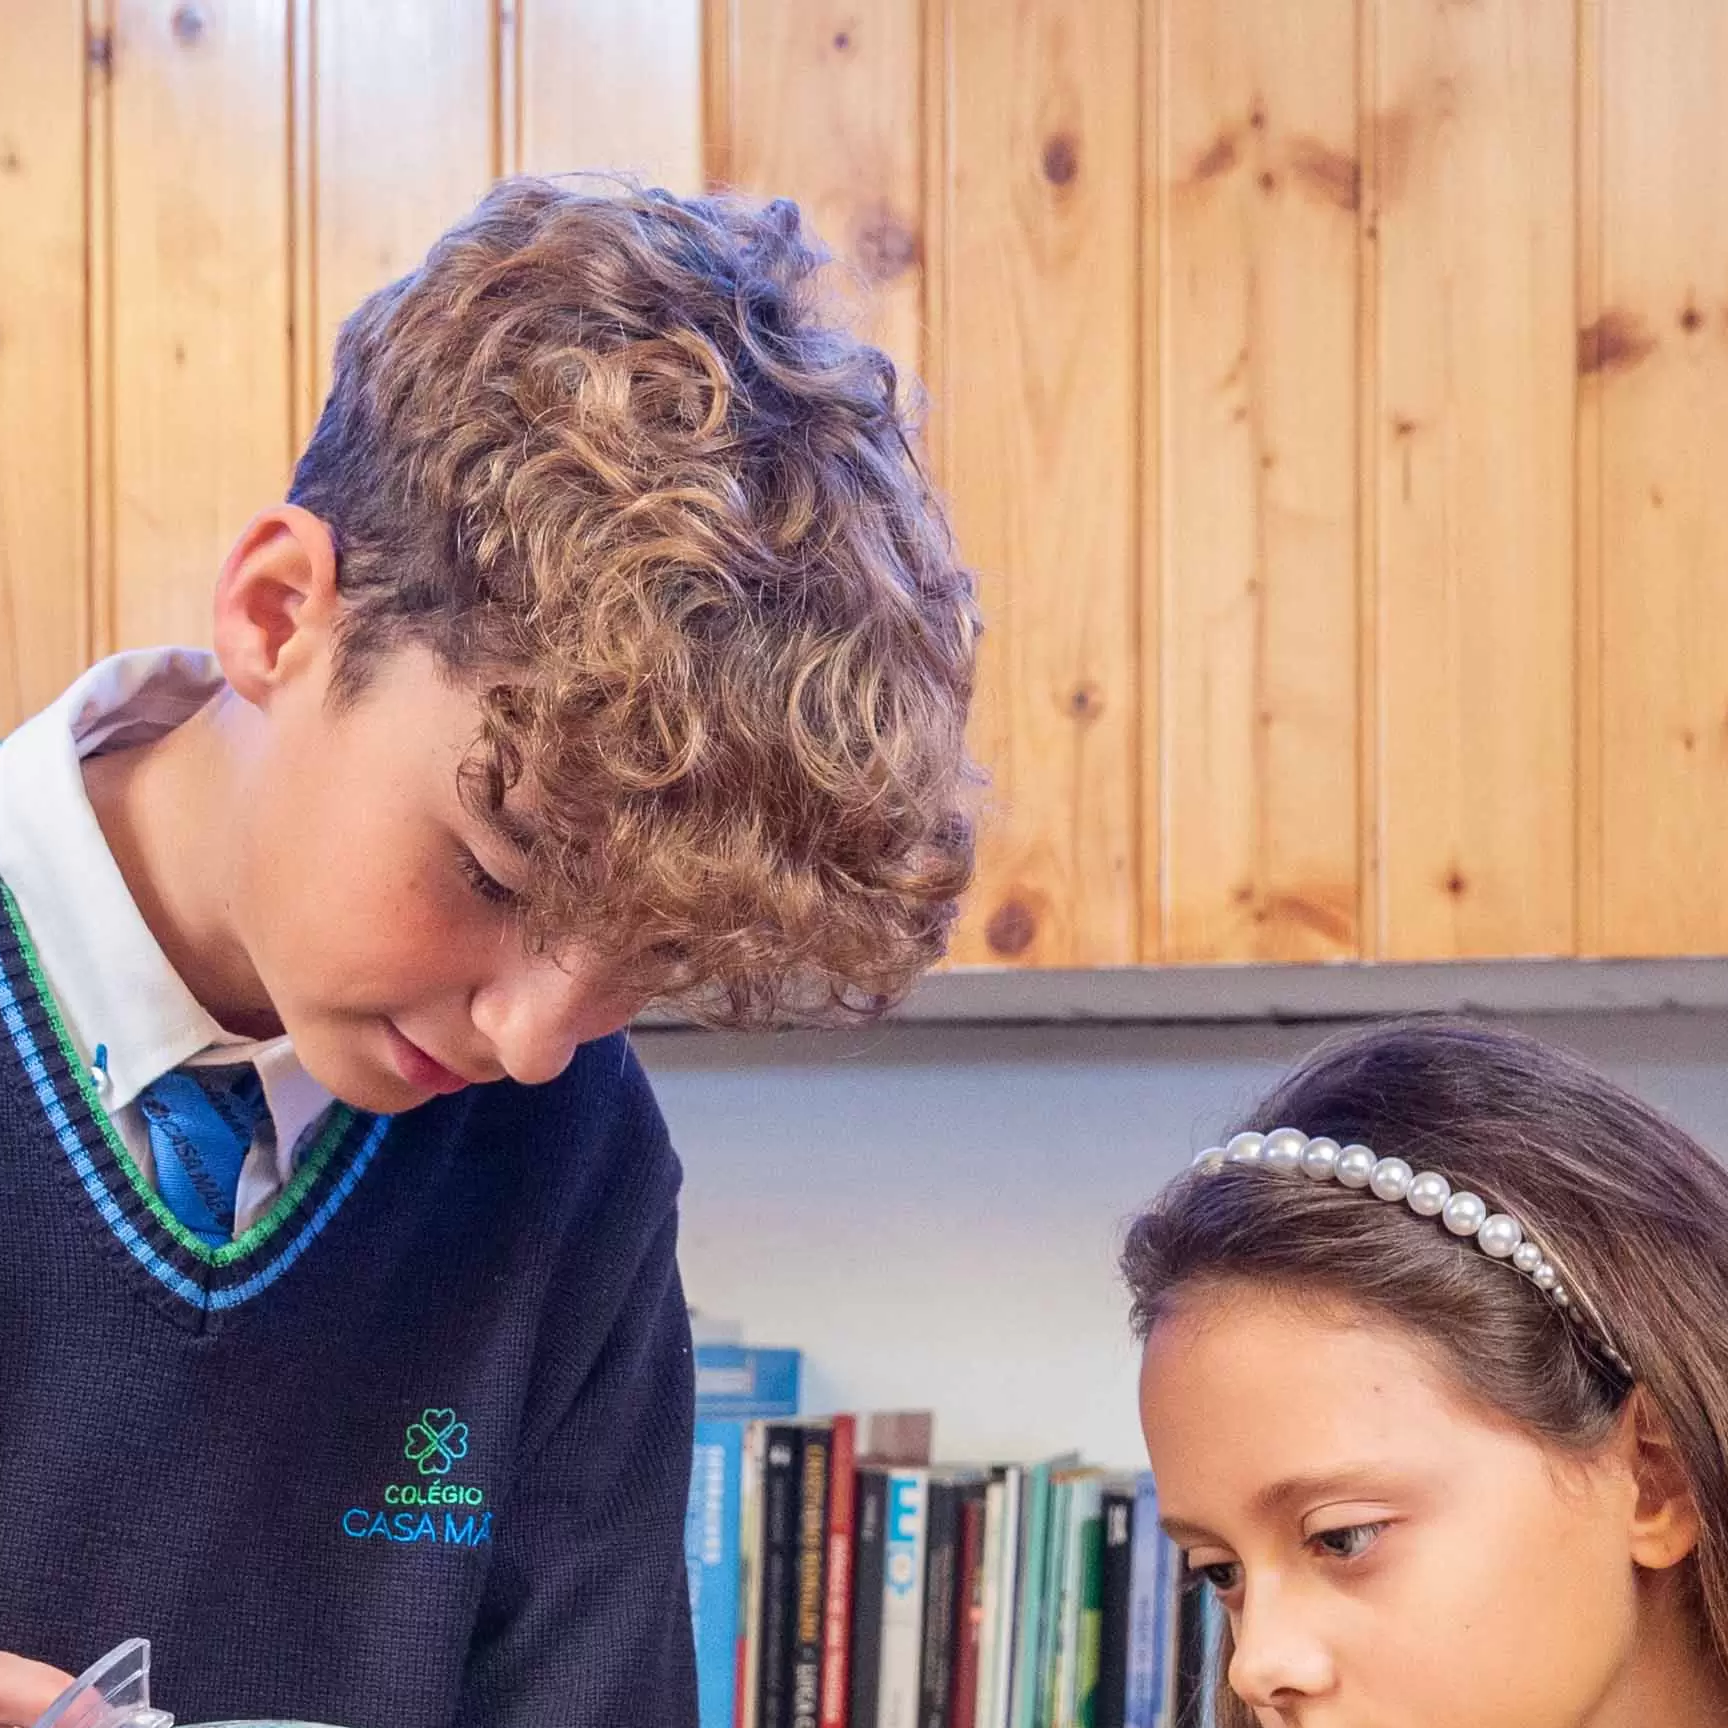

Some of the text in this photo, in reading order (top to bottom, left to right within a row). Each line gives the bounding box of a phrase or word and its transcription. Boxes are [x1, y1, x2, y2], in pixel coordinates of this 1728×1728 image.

[384, 1479, 483, 1505] COLÉGIO
[343, 1507, 493, 1547] CASA MÃ
